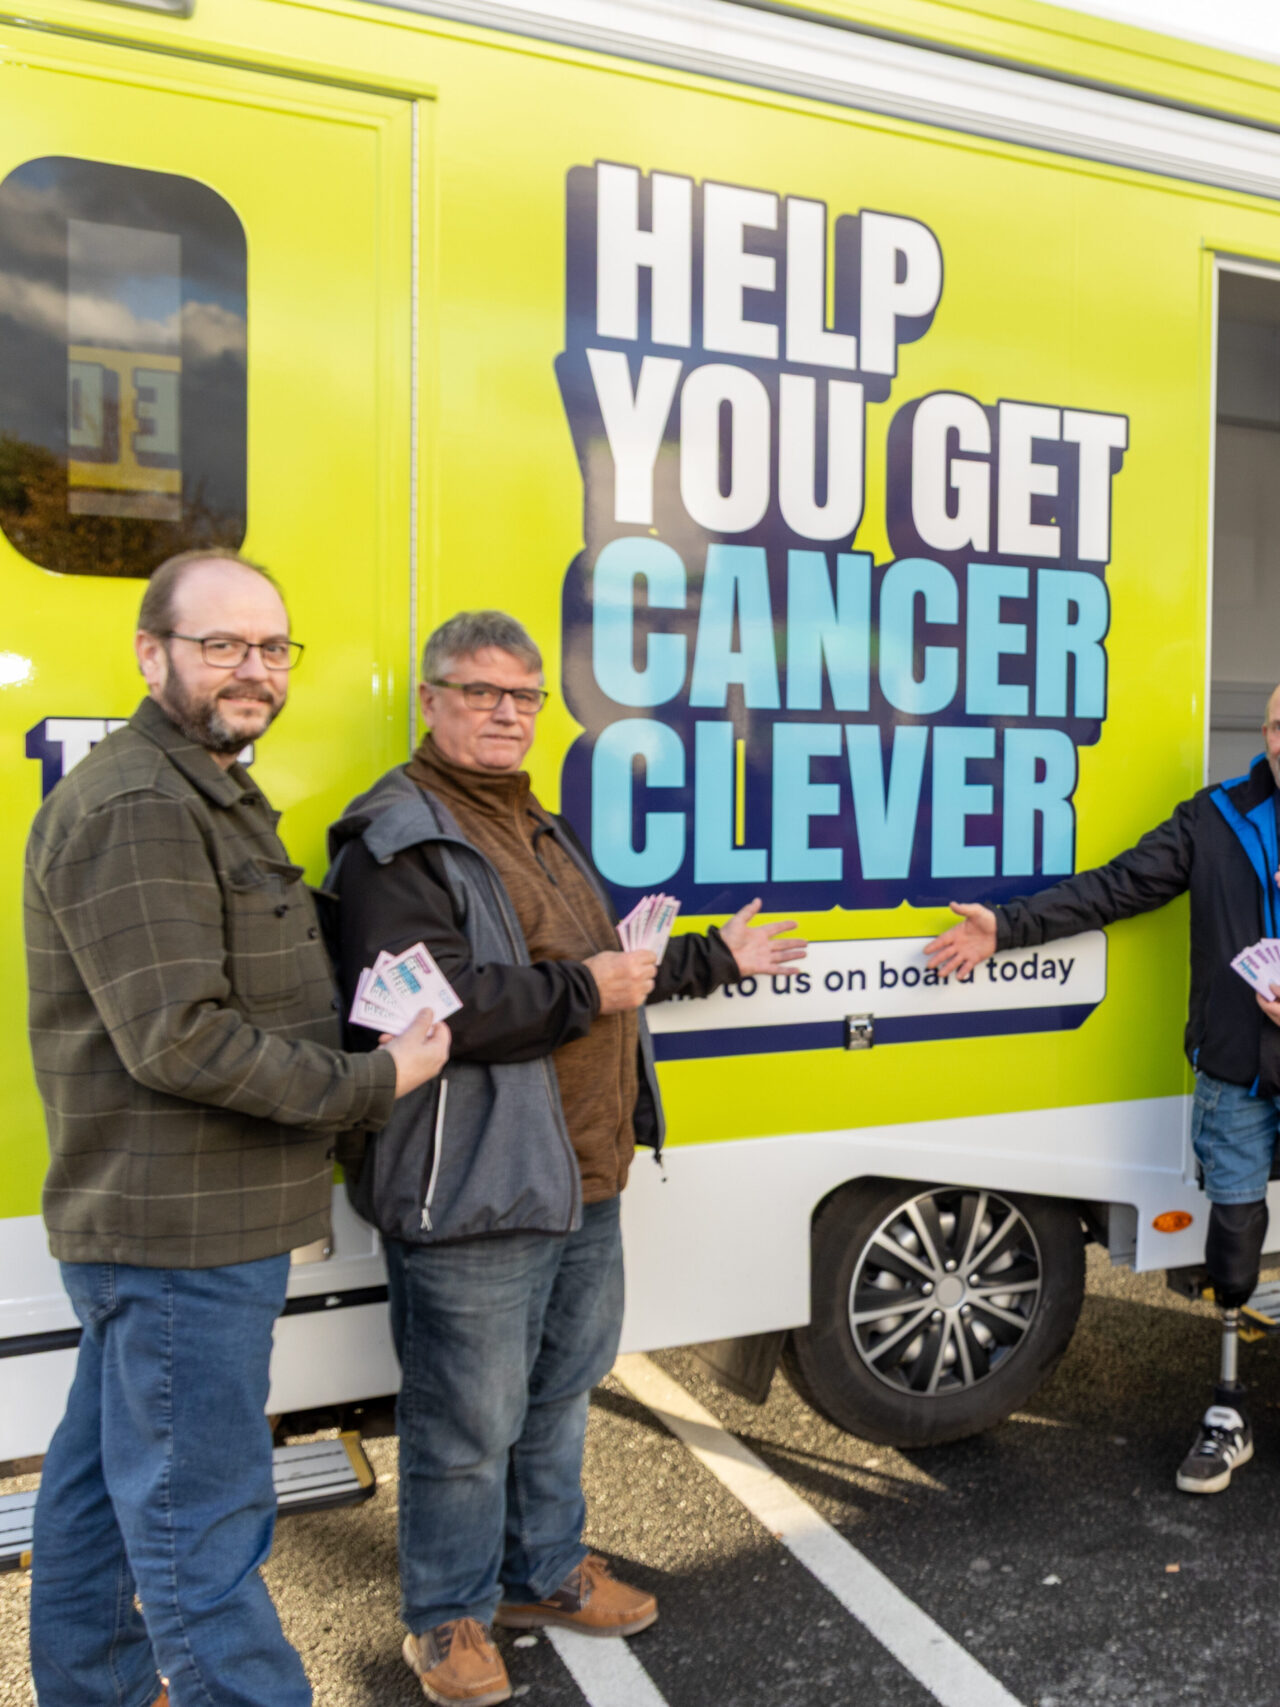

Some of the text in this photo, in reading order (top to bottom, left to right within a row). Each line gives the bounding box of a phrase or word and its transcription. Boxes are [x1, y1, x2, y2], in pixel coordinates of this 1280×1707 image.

[595, 161, 942, 377] HELP
[585, 348, 1128, 563] YOU GET
[591, 536, 1108, 719] CANCER
[590, 718, 1077, 888] CLEVER
[772, 972, 811, 994] us
[824, 970, 866, 992] on
[986, 953, 1075, 985] today
